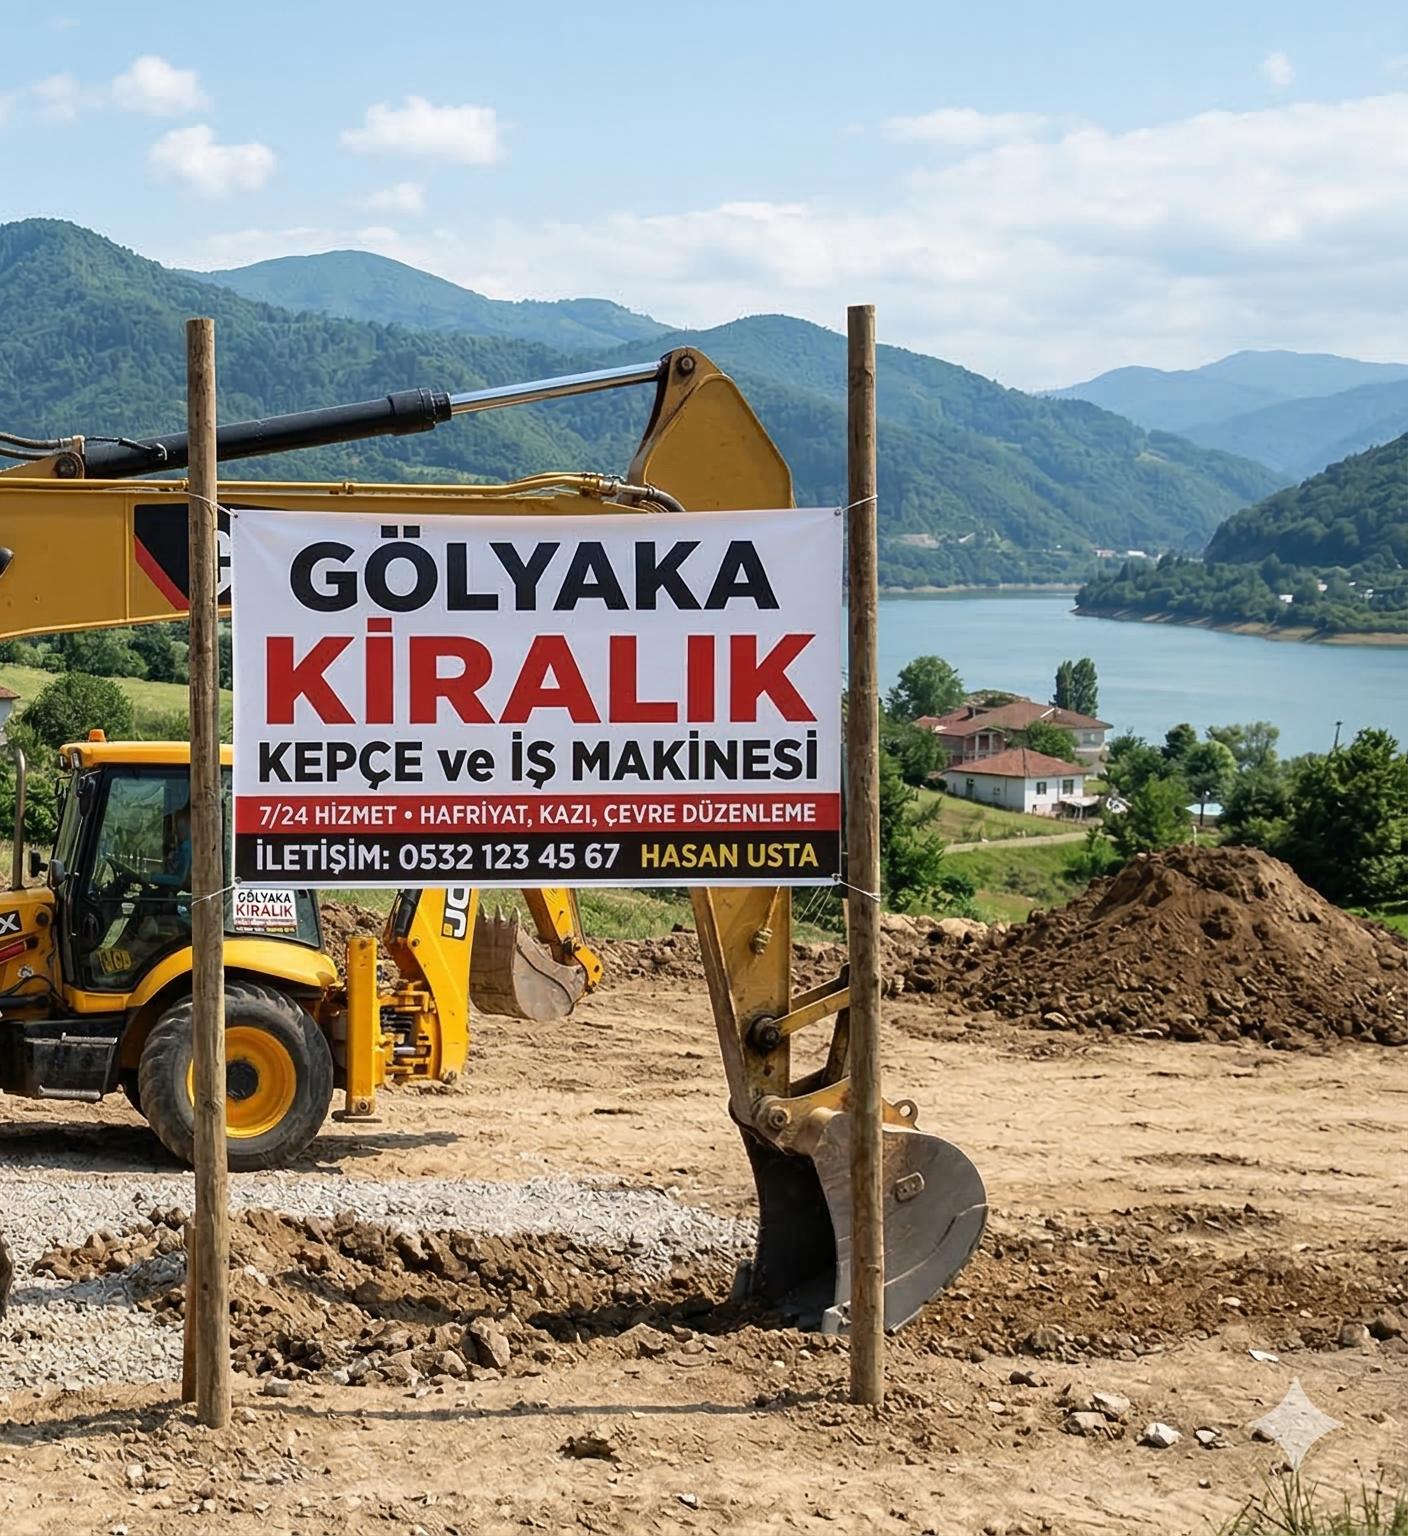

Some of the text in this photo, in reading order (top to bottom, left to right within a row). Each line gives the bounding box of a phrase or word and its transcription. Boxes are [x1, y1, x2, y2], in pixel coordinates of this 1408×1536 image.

[289, 525, 781, 612] GÖLYAKA
[265, 618, 818, 724] KİRALIK
[259, 730, 818, 790] KEPÇE ve İŞ MAKİNESİ
[259, 799, 817, 829] 7/24 HİZMET HAFRİYAT, KAZI, ÇEVRE DÜZENLEME
[256, 838, 819, 875] İLETİŞİM: 0532 123 45 67 HASAN USTA
